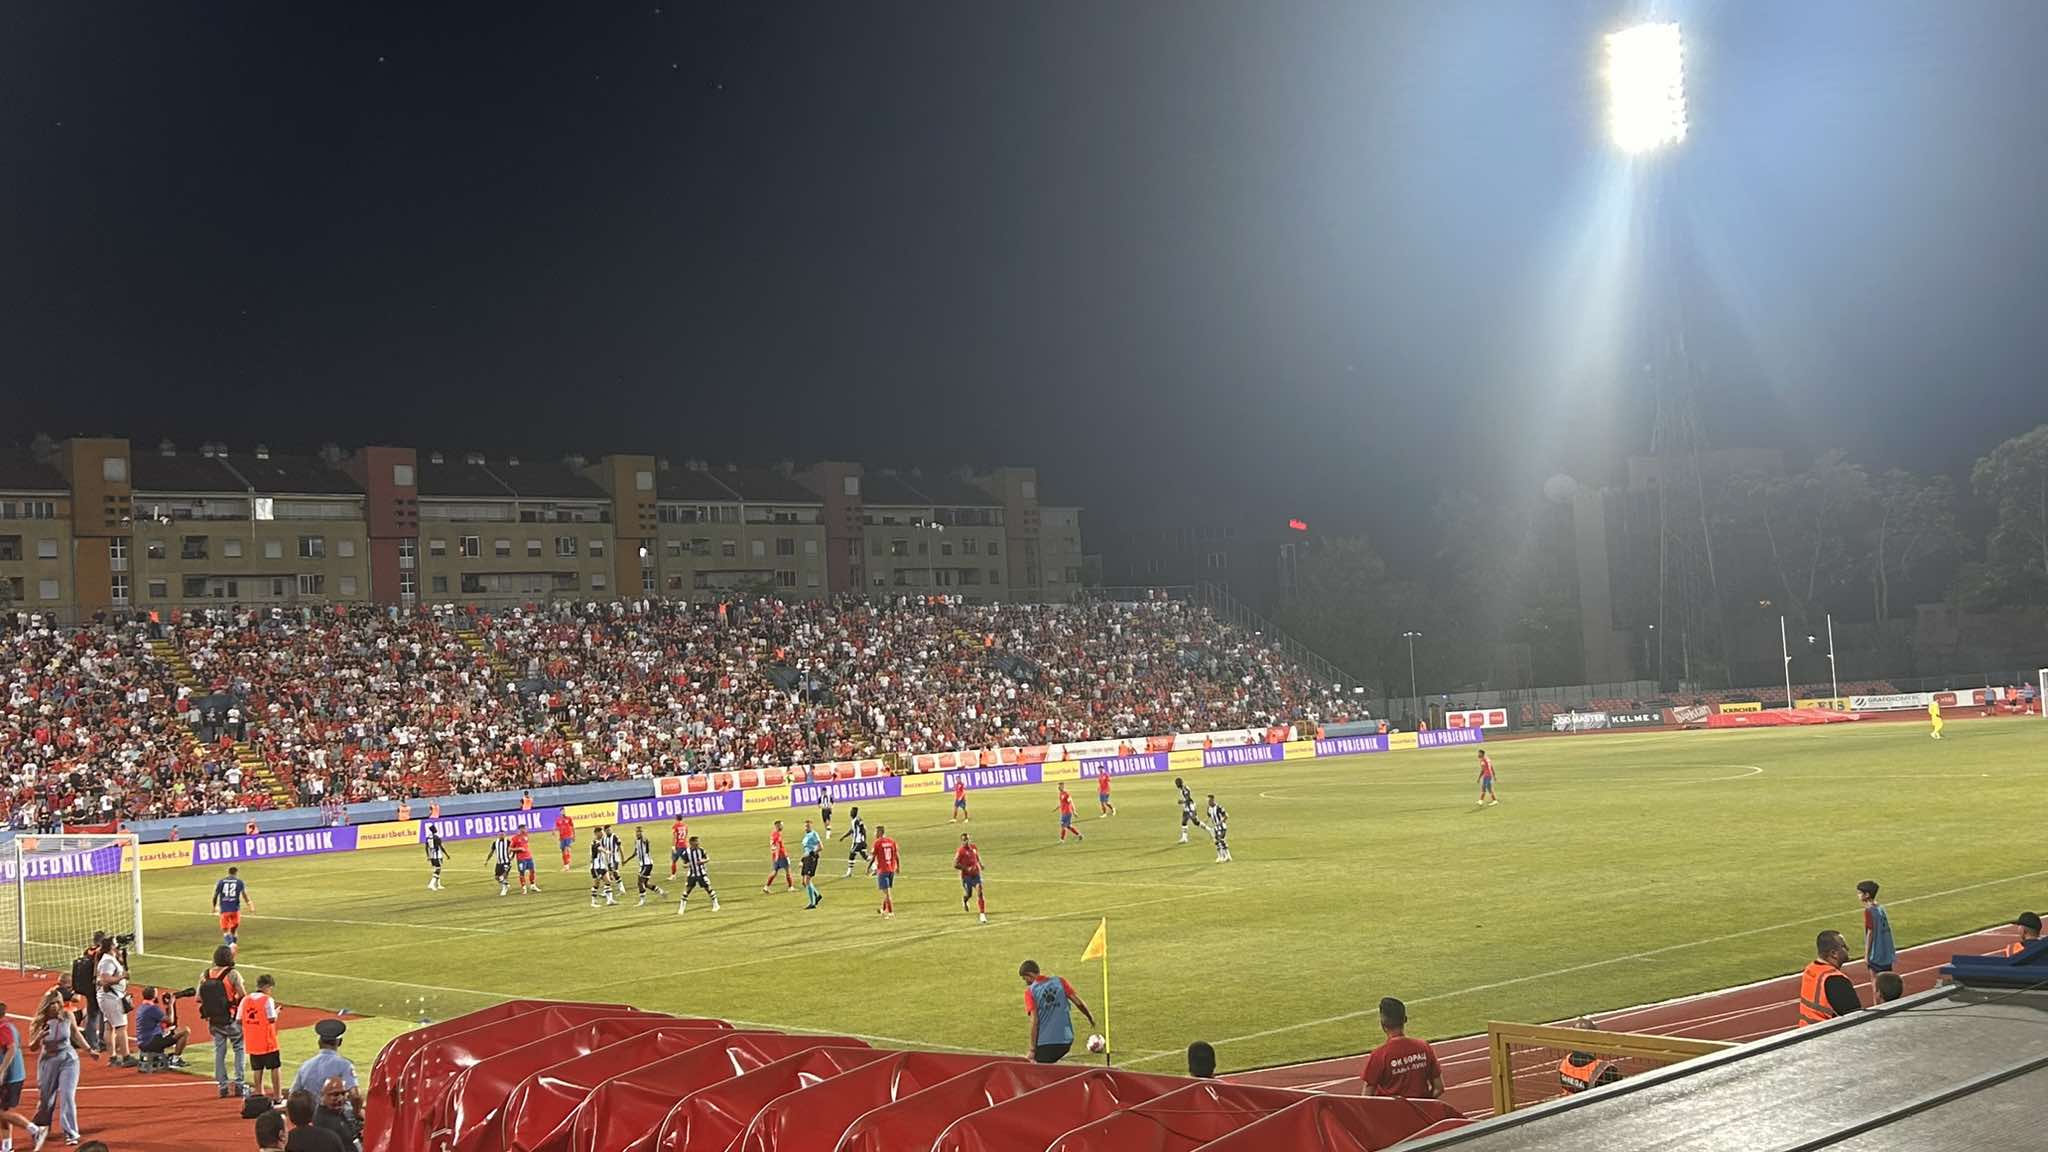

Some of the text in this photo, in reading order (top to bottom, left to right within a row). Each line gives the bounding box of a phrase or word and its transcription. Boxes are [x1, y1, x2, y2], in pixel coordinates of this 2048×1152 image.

[1612, 713, 1650, 723] KELME
[975, 767, 1028, 786] POBJEDNIK
[621, 795, 725, 820] BUDI POBJEDNIK
[465, 812, 543, 835] POBJEDNIK
[198, 831, 334, 861] BUDI POBJEDNIK
[222, 882, 237, 897] 42
